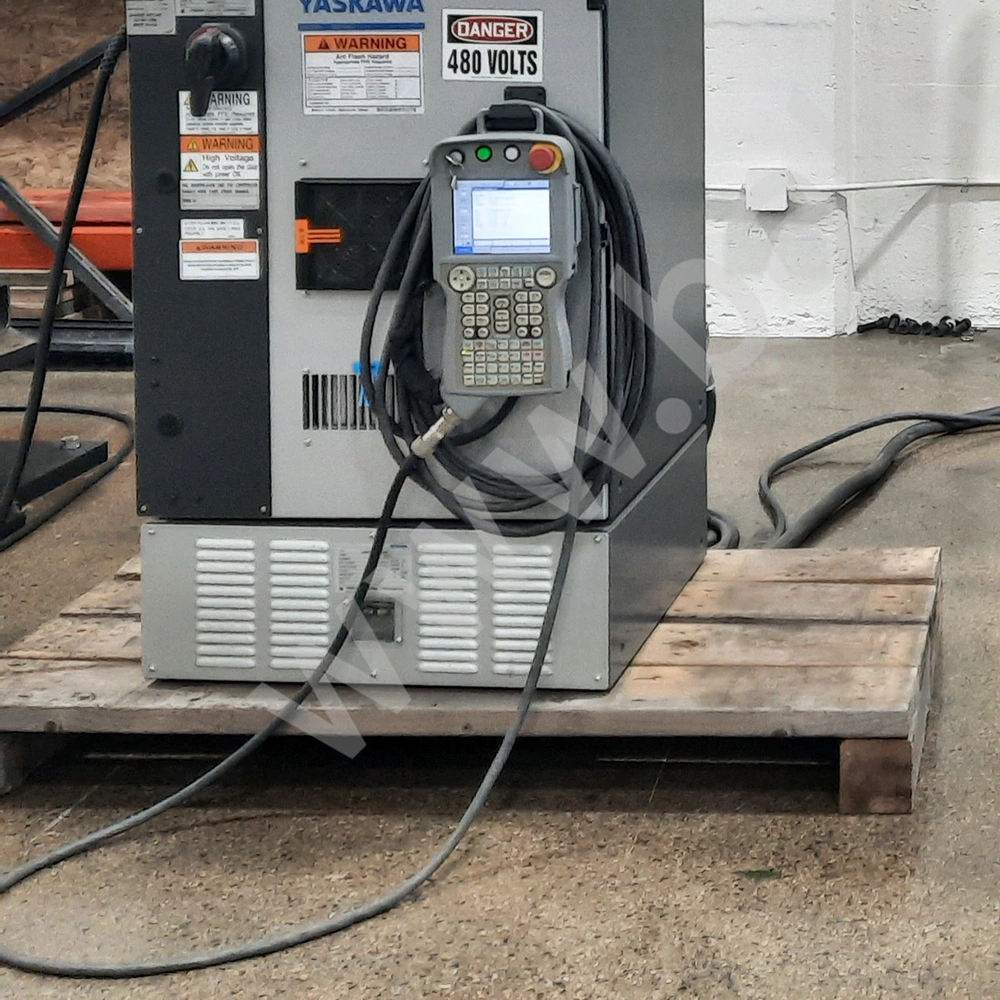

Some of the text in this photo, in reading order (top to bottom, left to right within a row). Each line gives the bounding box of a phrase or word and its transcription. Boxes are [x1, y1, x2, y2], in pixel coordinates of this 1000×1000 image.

[457, 22, 530, 38] DANGER
[334, 37, 407, 50] WARNING
[447, 49, 538, 75] 480 VOLTS
[210, 93, 250, 106] ARNING
[202, 138, 253, 150] WARNING
[202, 154, 220, 163] High
